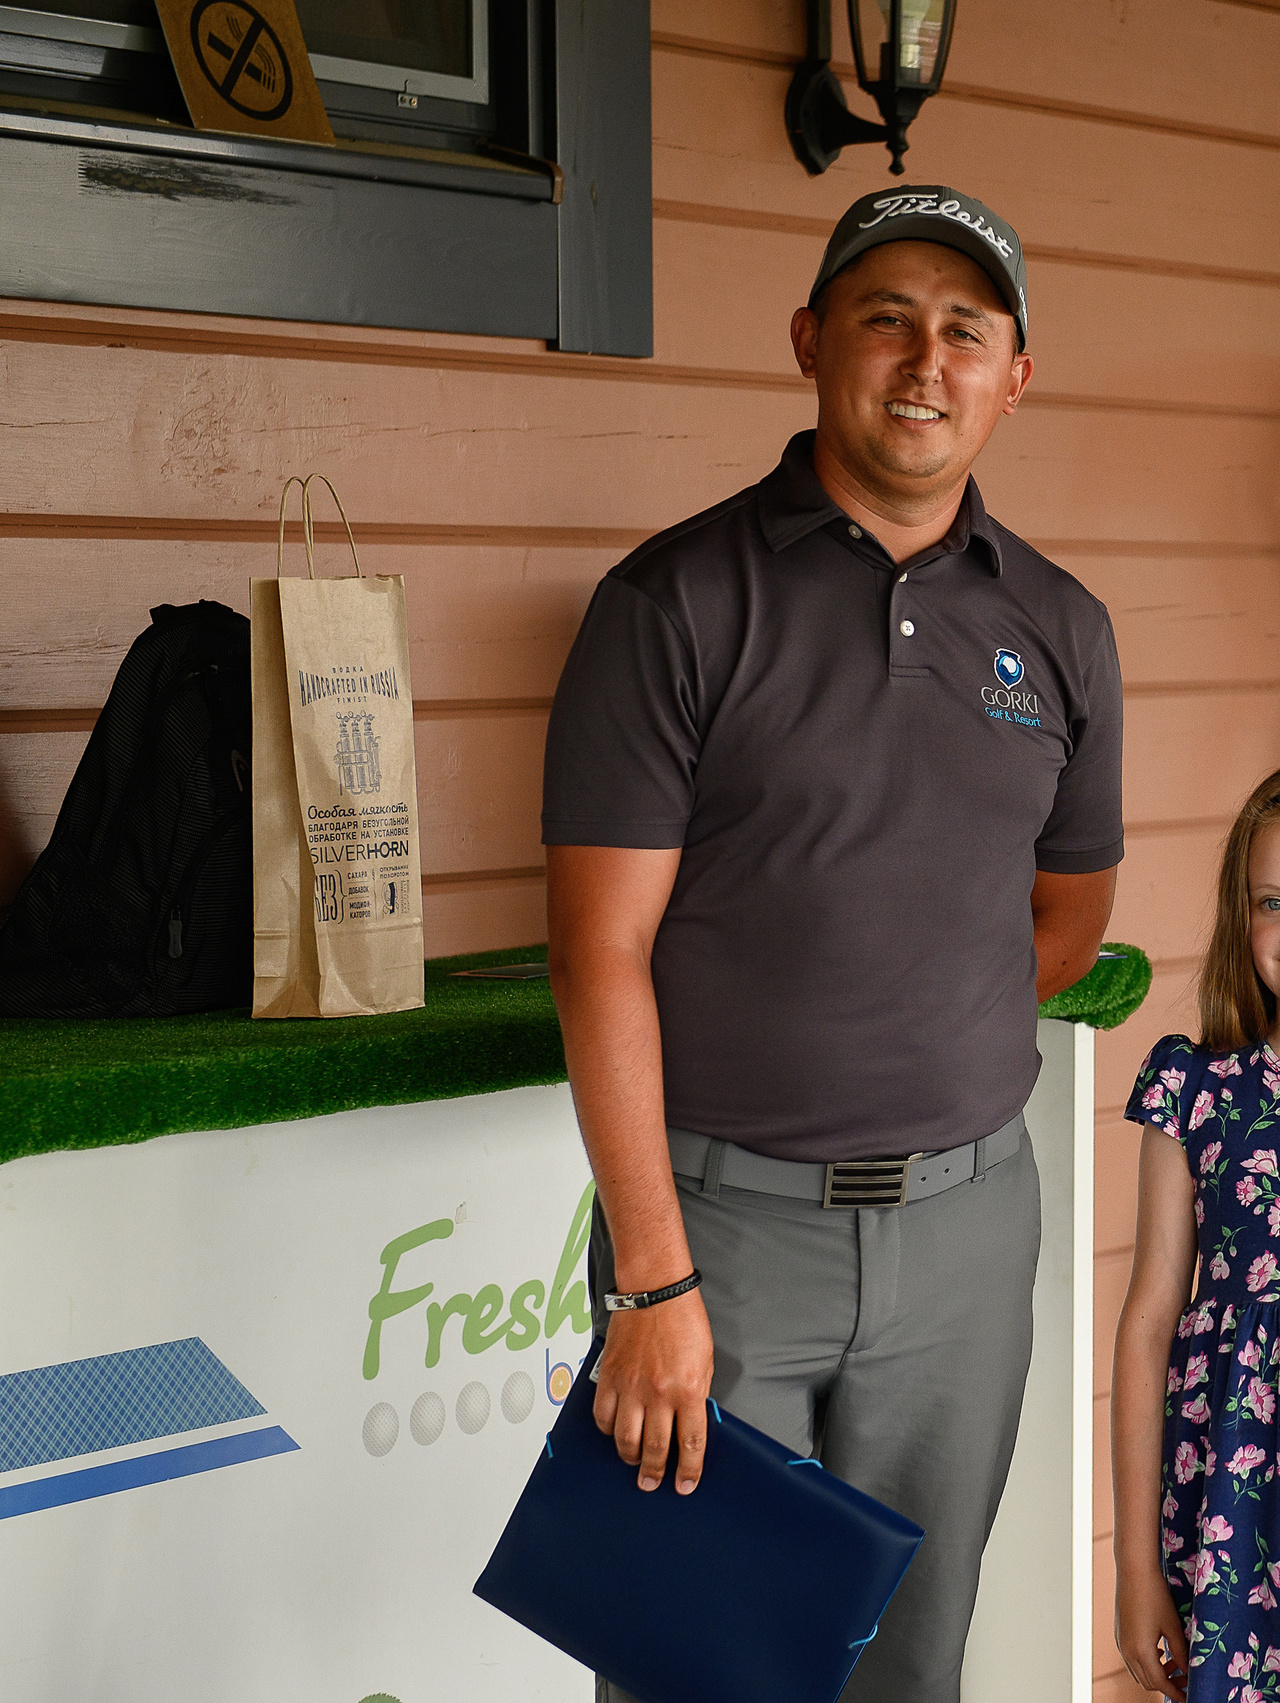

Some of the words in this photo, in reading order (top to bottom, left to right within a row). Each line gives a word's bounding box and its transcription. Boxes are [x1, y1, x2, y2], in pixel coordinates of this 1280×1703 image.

[858, 193, 1014, 259] Titleist
[298, 669, 357, 707] HANDCRAFTED
[359, 676, 369, 693] IN
[370, 666, 400, 701] RUSSIA
[980, 686, 1039, 714] GORKI
[985, 706, 1004, 720] Golf
[1013, 711, 1042, 727] Resort
[307, 805, 357, 820] Особая
[358, 802, 408, 817] мягкость
[308, 820, 359, 833] БЛАГОДАРЯ
[362, 815, 410, 829] БЕЗУГОЛЬНОЙ
[308, 831, 358, 843] ОБРАБОТКЕ
[360, 830, 371, 840] НА
[373, 827, 409, 838] УСТАНОВКЕ
[309, 839, 409, 865] SILVERHORN
[347, 870, 368, 880] САХАРА
[362, 1178, 596, 1381] Fresh
